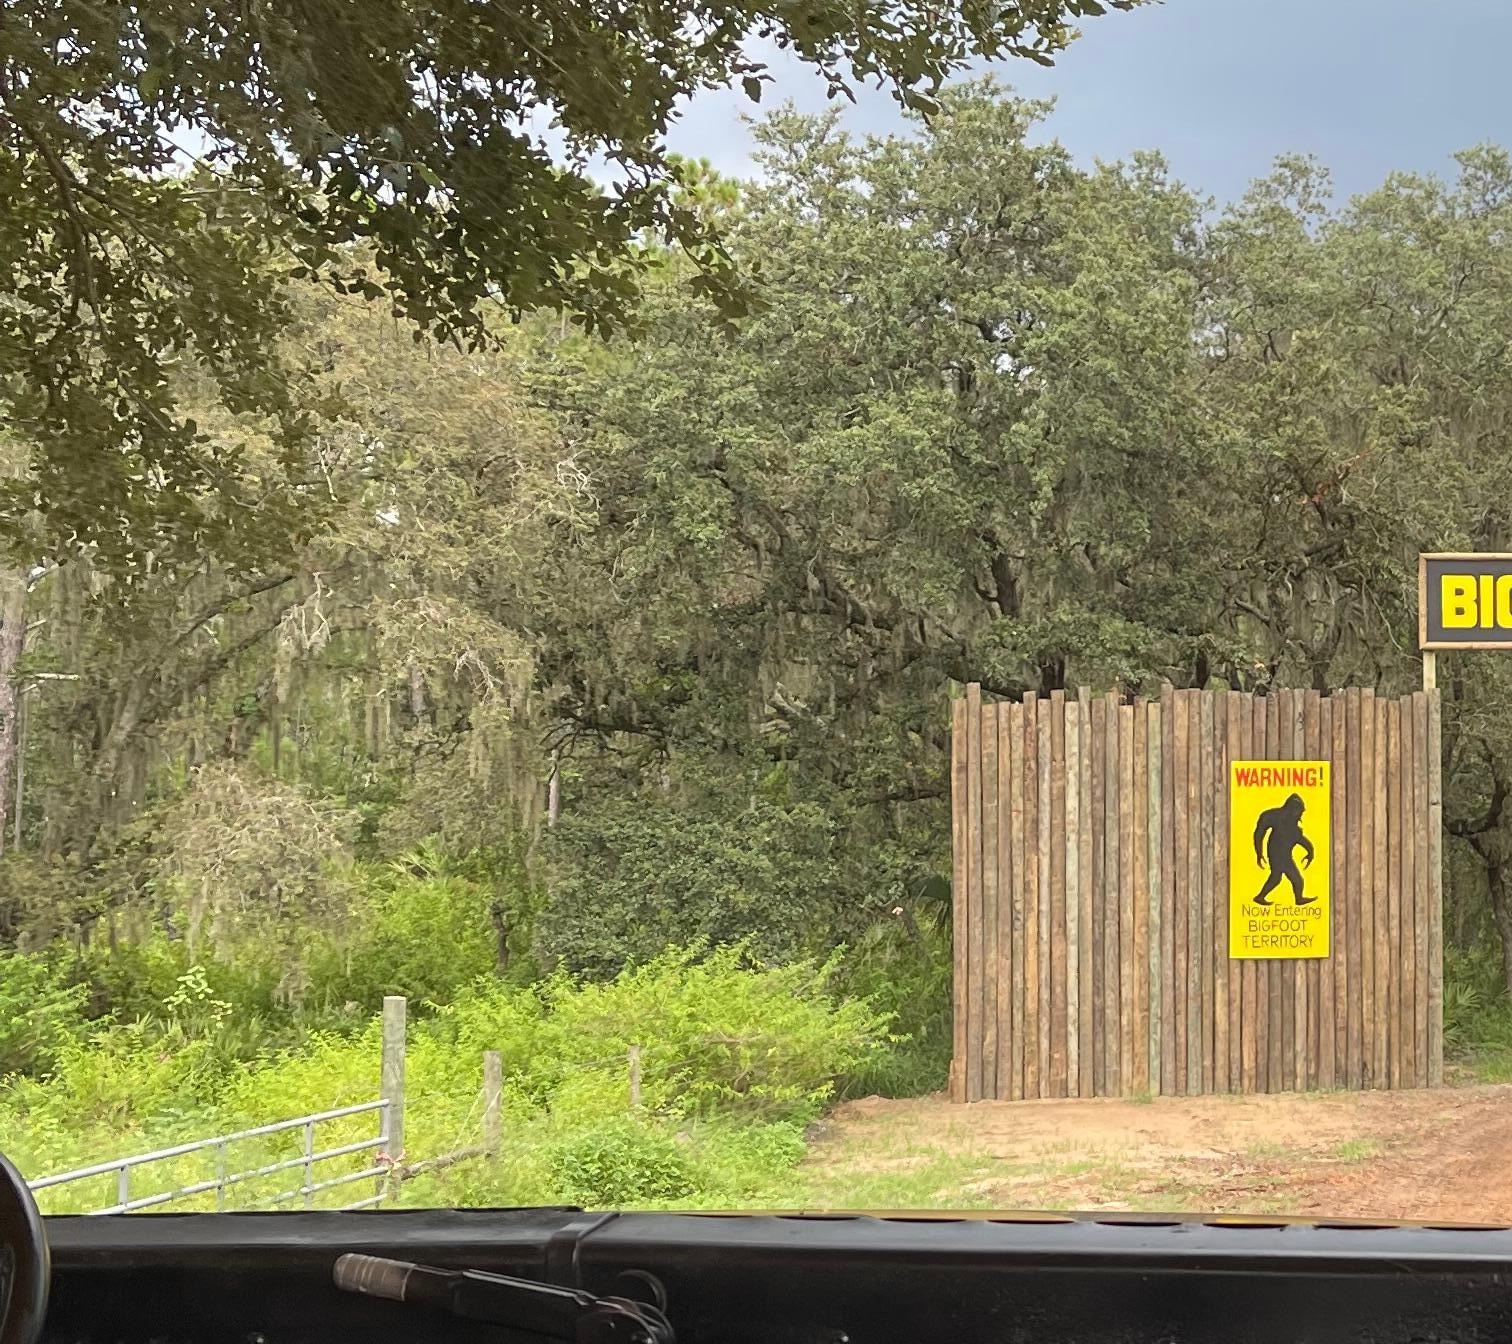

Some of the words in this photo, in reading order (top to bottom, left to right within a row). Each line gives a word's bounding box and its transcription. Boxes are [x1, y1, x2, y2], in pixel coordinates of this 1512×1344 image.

[1235, 766, 1324, 787] WARNING!
[1242, 904, 1271, 917] Now
[1275, 904, 1322, 920] Entering
[1248, 920, 1308, 932] BIGFOOT
[1243, 935, 1314, 949] TERRITORY
